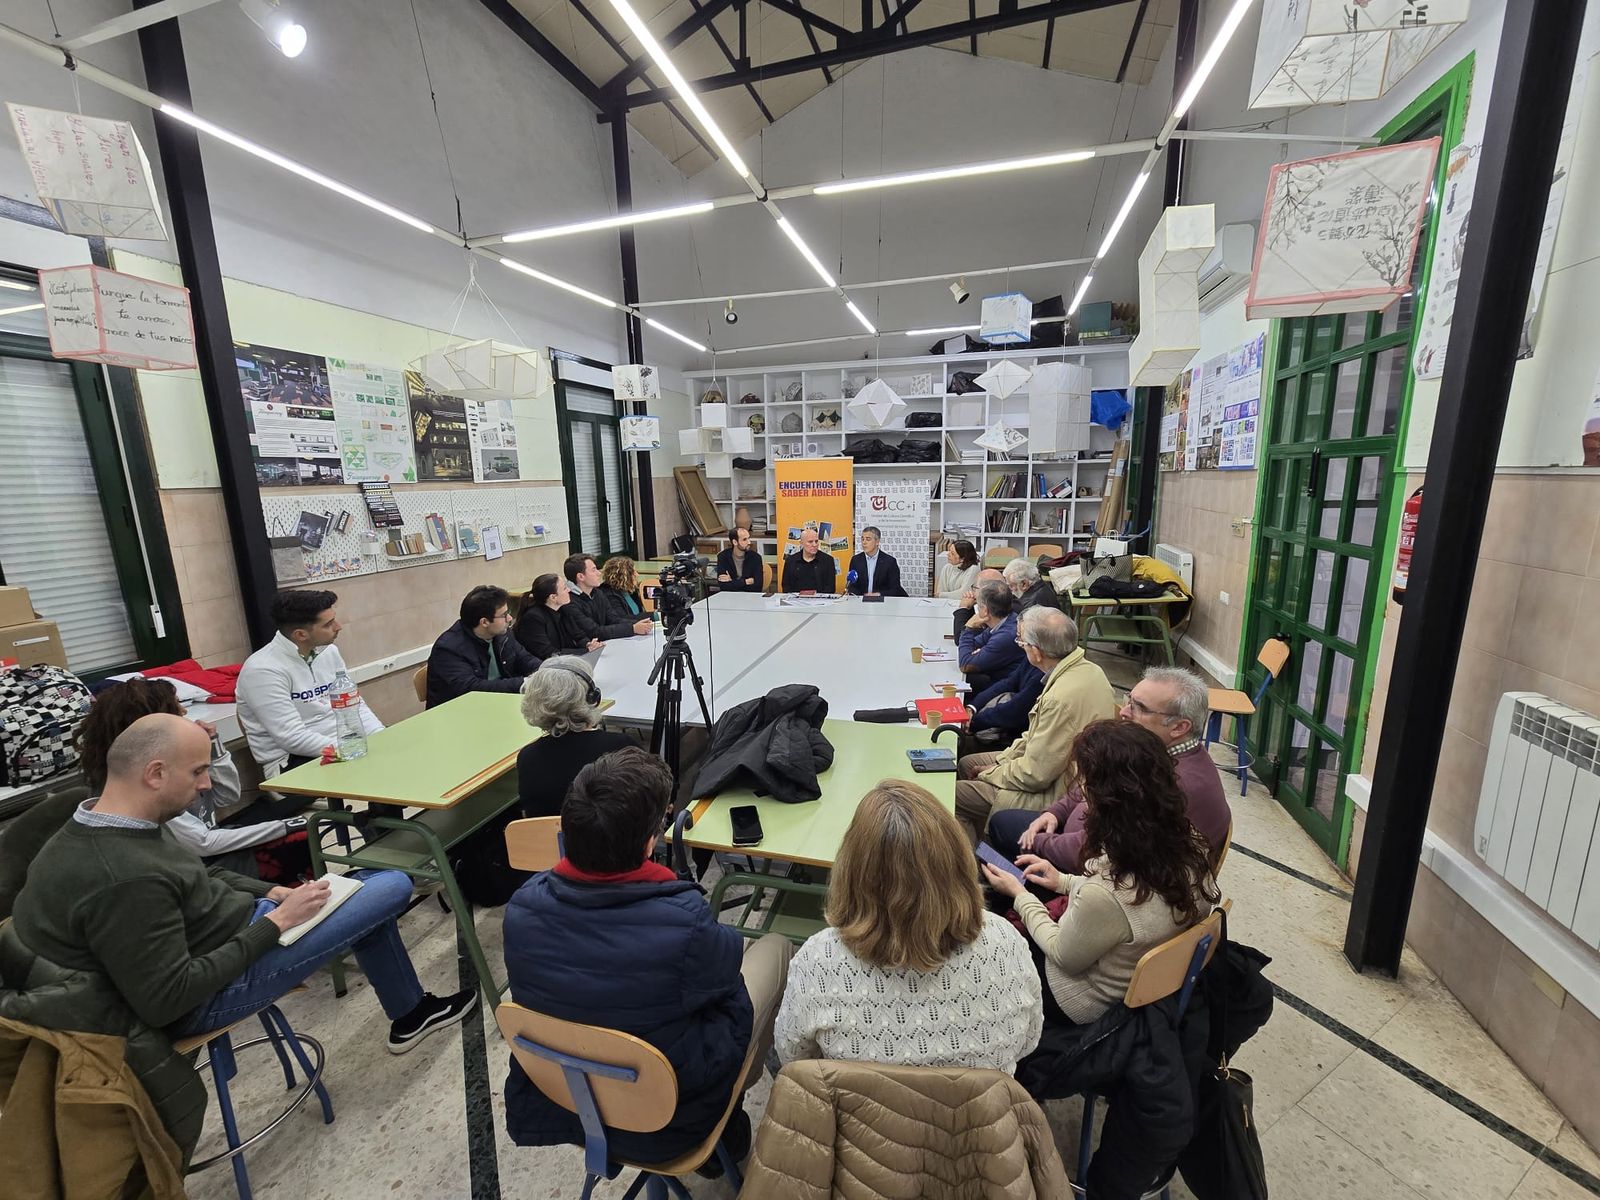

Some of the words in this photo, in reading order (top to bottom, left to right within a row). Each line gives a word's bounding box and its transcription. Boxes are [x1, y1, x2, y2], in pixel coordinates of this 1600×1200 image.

[779, 481, 835, 490] ENCUENTROS
[836, 480, 847, 489] DE
[781, 489, 809, 498] SABER
[812, 489, 847, 497] ABIERTO
